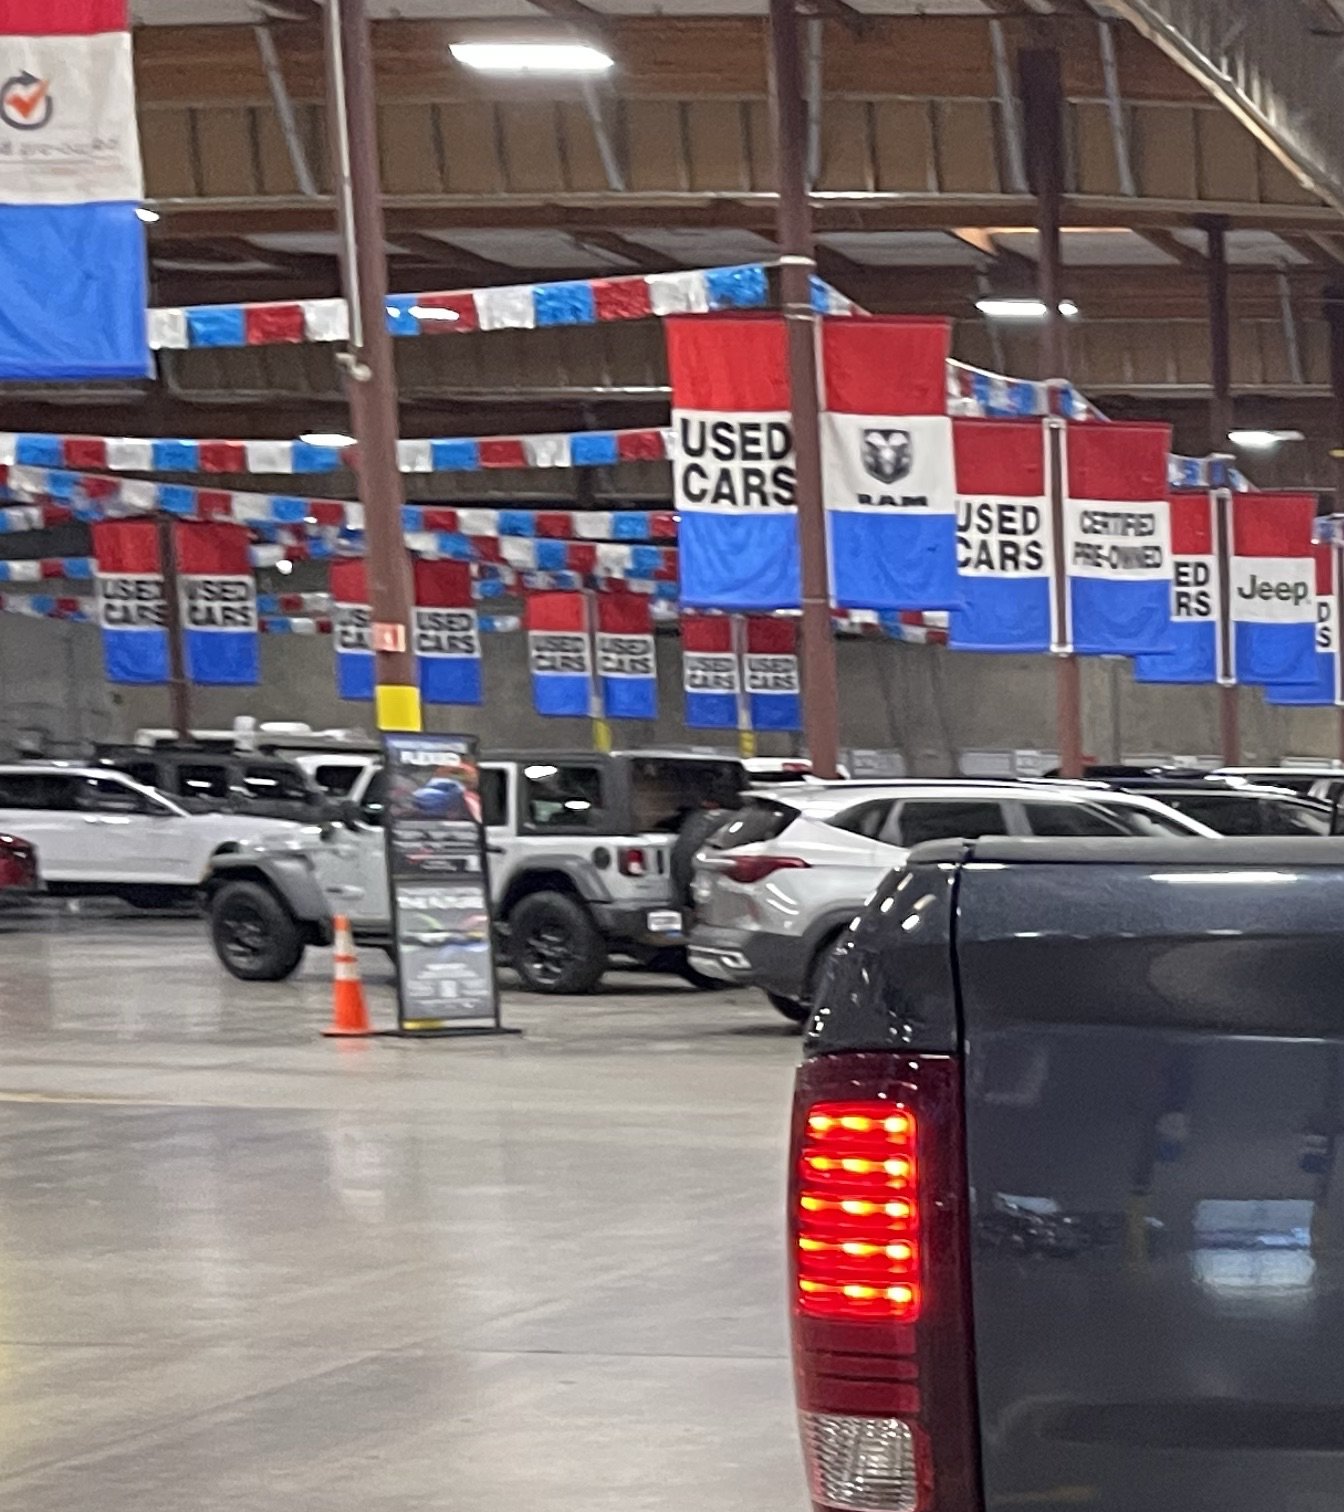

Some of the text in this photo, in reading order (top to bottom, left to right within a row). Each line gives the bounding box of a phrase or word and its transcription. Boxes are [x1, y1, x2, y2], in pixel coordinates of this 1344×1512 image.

[681, 418, 793, 461] USED
[682, 463, 798, 506] CARS
[1173, 561, 1210, 587] ED
[1237, 574, 1309, 605] Jeep
[1174, 591, 1212, 617] RS
